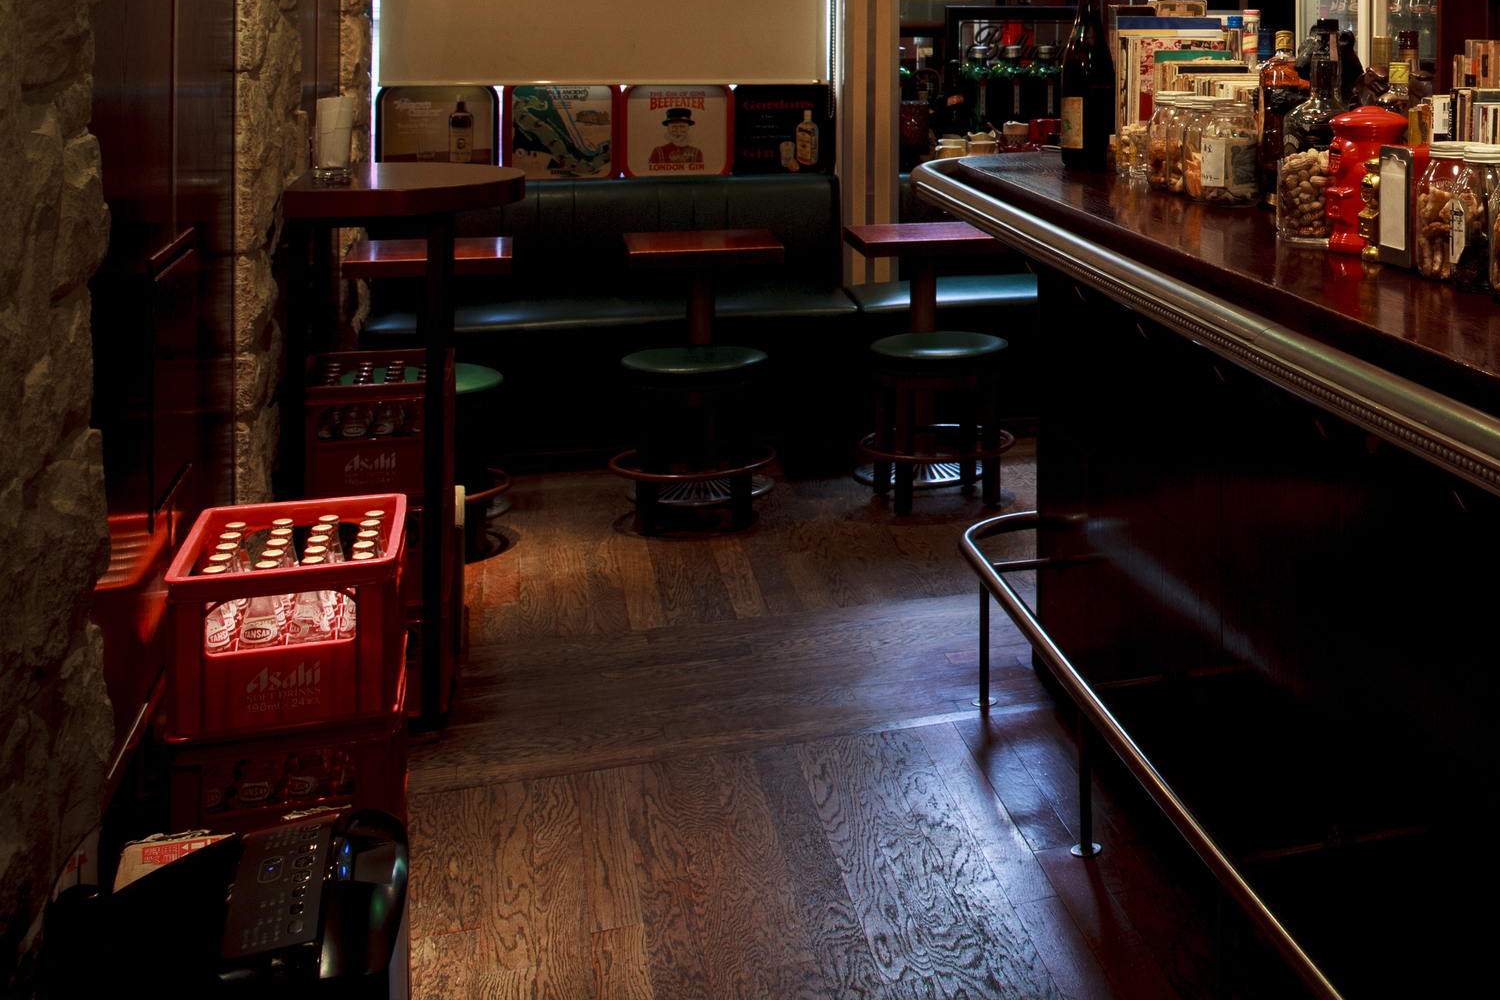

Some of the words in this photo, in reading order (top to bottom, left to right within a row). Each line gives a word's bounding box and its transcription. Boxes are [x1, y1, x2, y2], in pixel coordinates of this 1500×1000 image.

[650, 97, 705, 111] BEEFEATER
[743, 100, 815, 110] Gordon's
[743, 148, 775, 158] Gin
[649, 163, 685, 171] LONDON
[689, 163, 705, 171] GIN
[344, 452, 396, 472] Asahi
[245, 628, 272, 639] TANSAN
[246, 660, 321, 694] Asahi
[247, 693, 274, 703] SOFT
[278, 687, 321, 699] DRINKS
[247, 701, 280, 714] 190ml
[291, 698, 321, 709] 24本入
